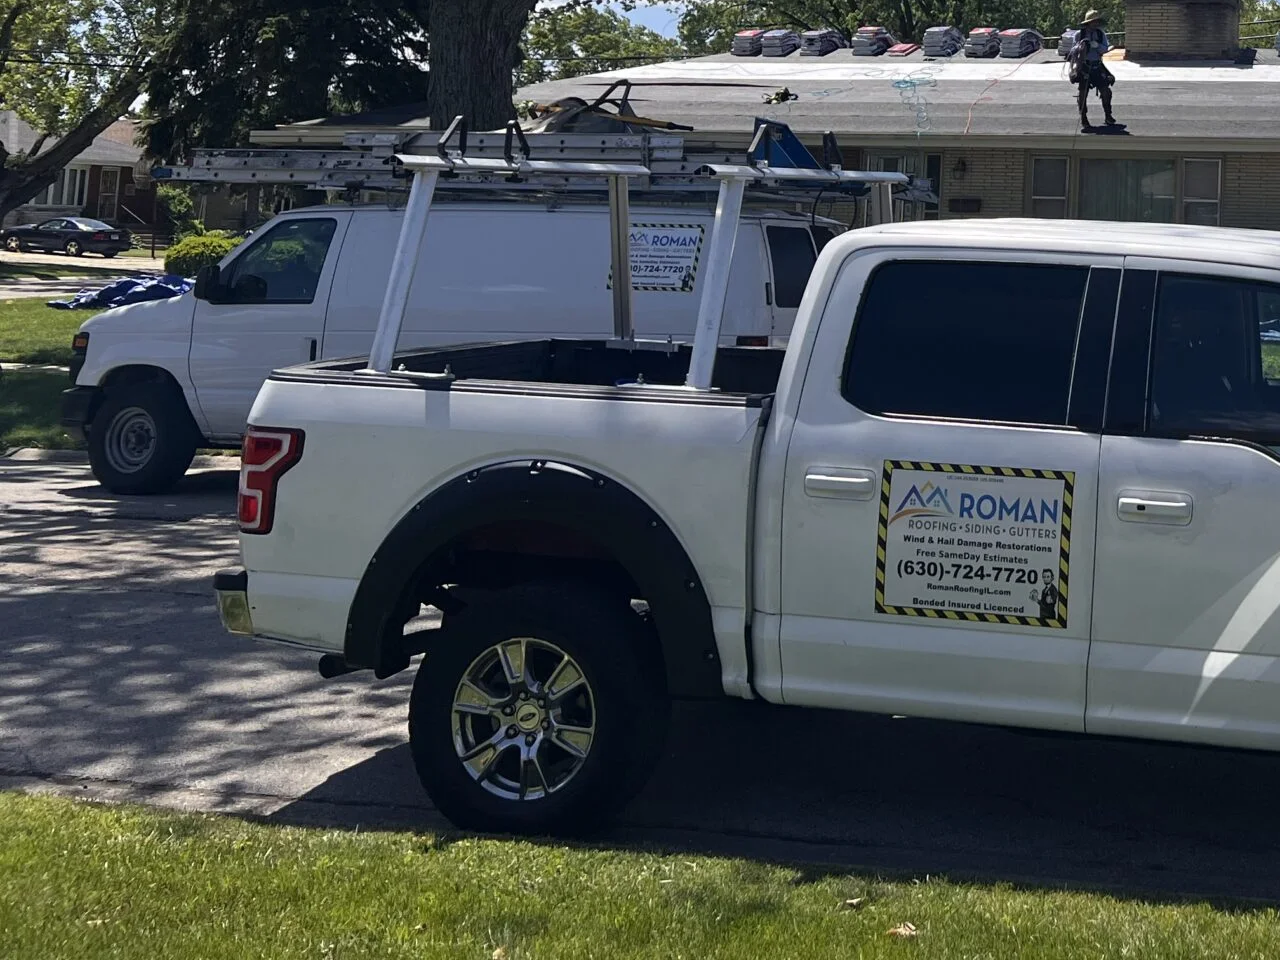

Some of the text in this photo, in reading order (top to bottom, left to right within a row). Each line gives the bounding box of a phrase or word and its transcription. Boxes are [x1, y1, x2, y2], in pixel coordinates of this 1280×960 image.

[651, 235, 698, 247] ROMAN
[630, 265, 684, 273] 0)-724-7720
[959, 493, 1058, 524] ROMAN
[908, 520, 1057, 539] ROOFING SIDING GUTTERS
[903, 534, 1052, 552] Wind & Hail Damage Restorations
[916, 548, 1029, 564] Free SameDay Estimates
[897, 559, 1038, 585] (630)-724-7720
[912, 597, 1025, 613] Bonded Insured Licenced
